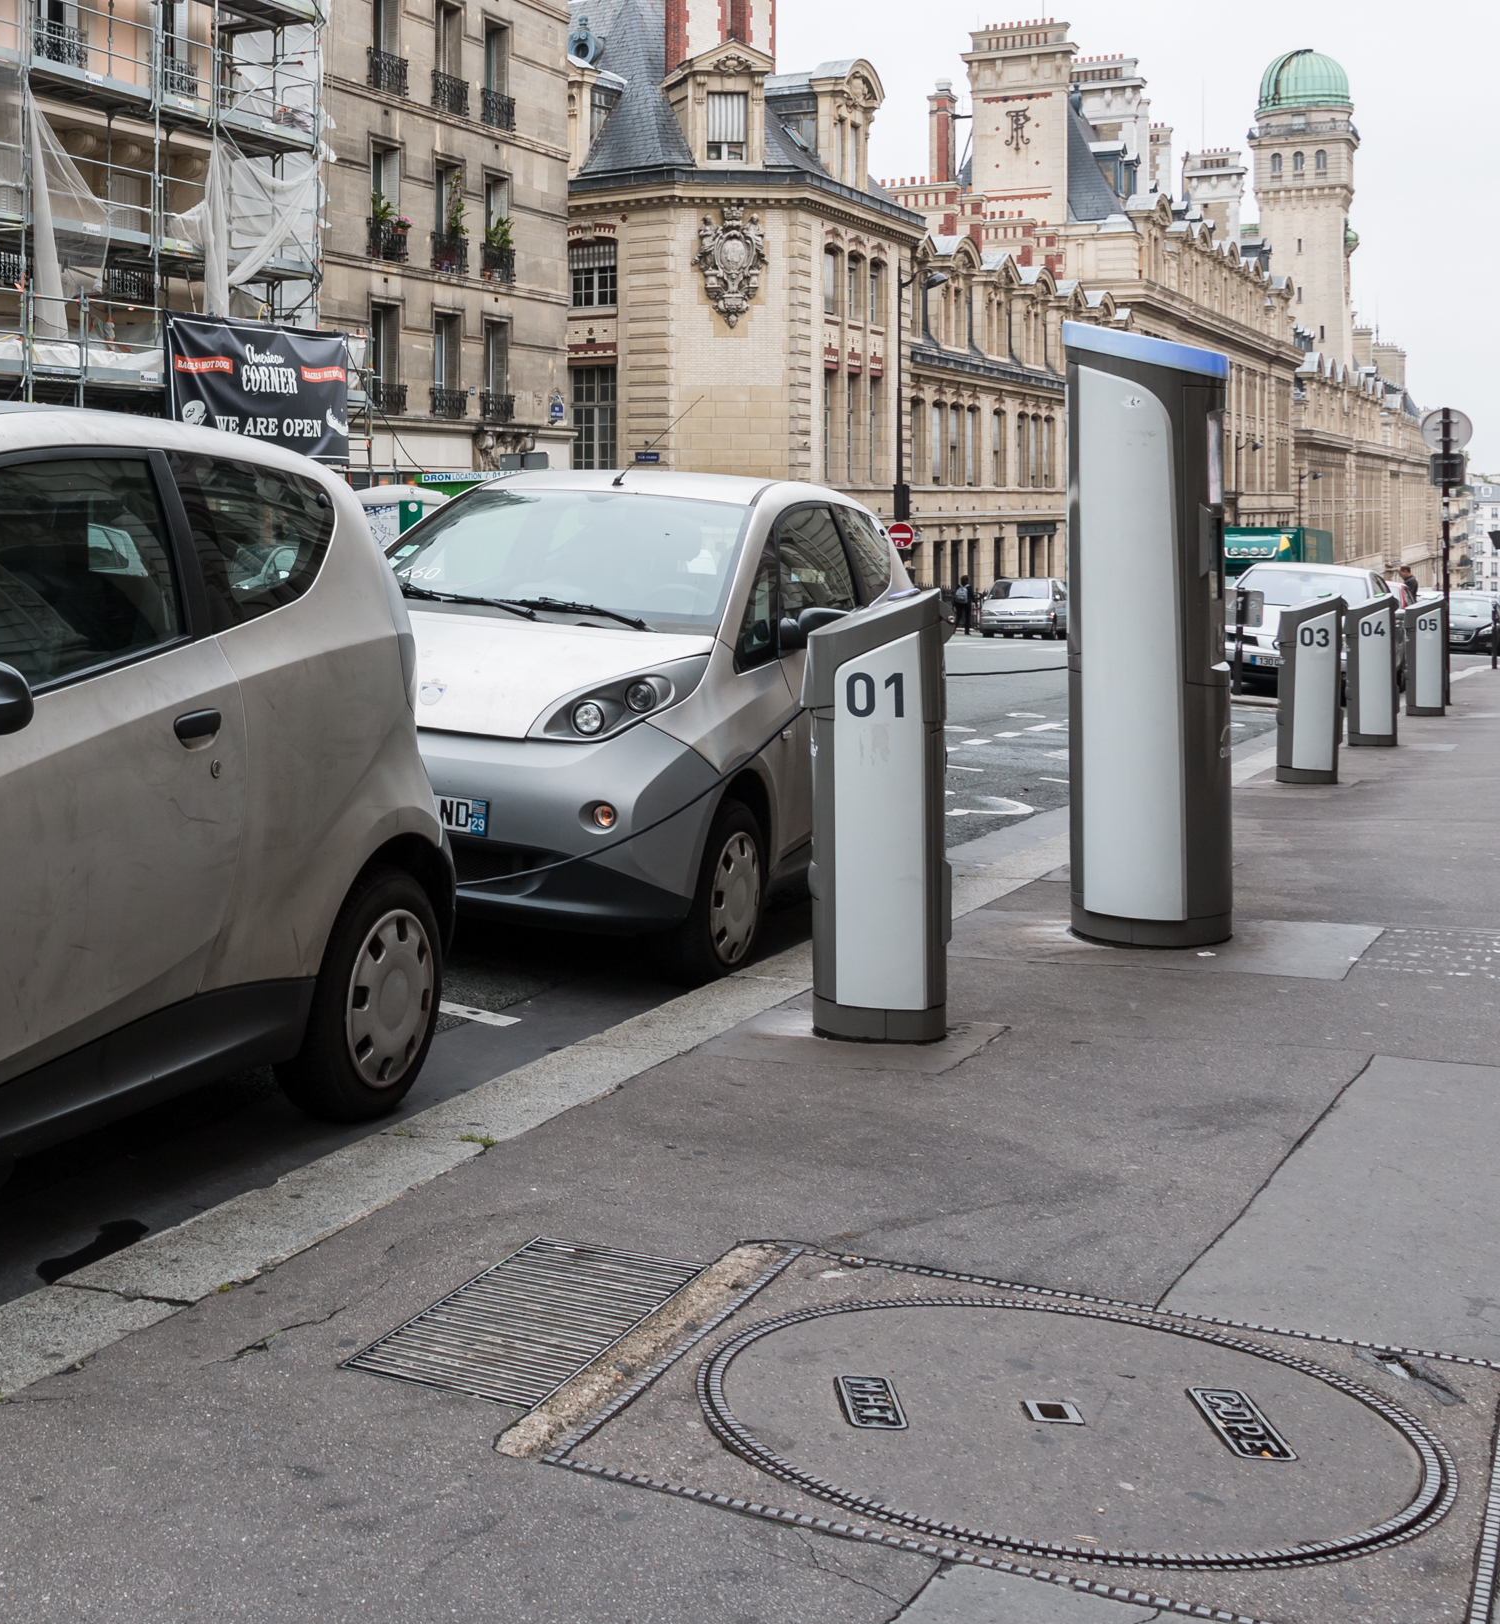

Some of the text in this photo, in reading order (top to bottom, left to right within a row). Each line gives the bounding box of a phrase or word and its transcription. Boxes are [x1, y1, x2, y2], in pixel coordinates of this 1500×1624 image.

[202, 360, 215, 370] HOT
[215, 360, 230, 370] DOGS
[242, 364, 299, 395] CORNER
[215, 416, 322, 437] WE ARE OPEN
[423, 473, 451, 482] DRON
[452, 472, 482, 480] LOCATION
[397, 566, 441, 580] 460
[1361, 621, 1386, 637] 04
[1418, 618, 1438, 632] 05
[1300, 627, 1330, 648] 03
[846, 672, 904, 718] 01
[471, 817, 485, 831] 29
